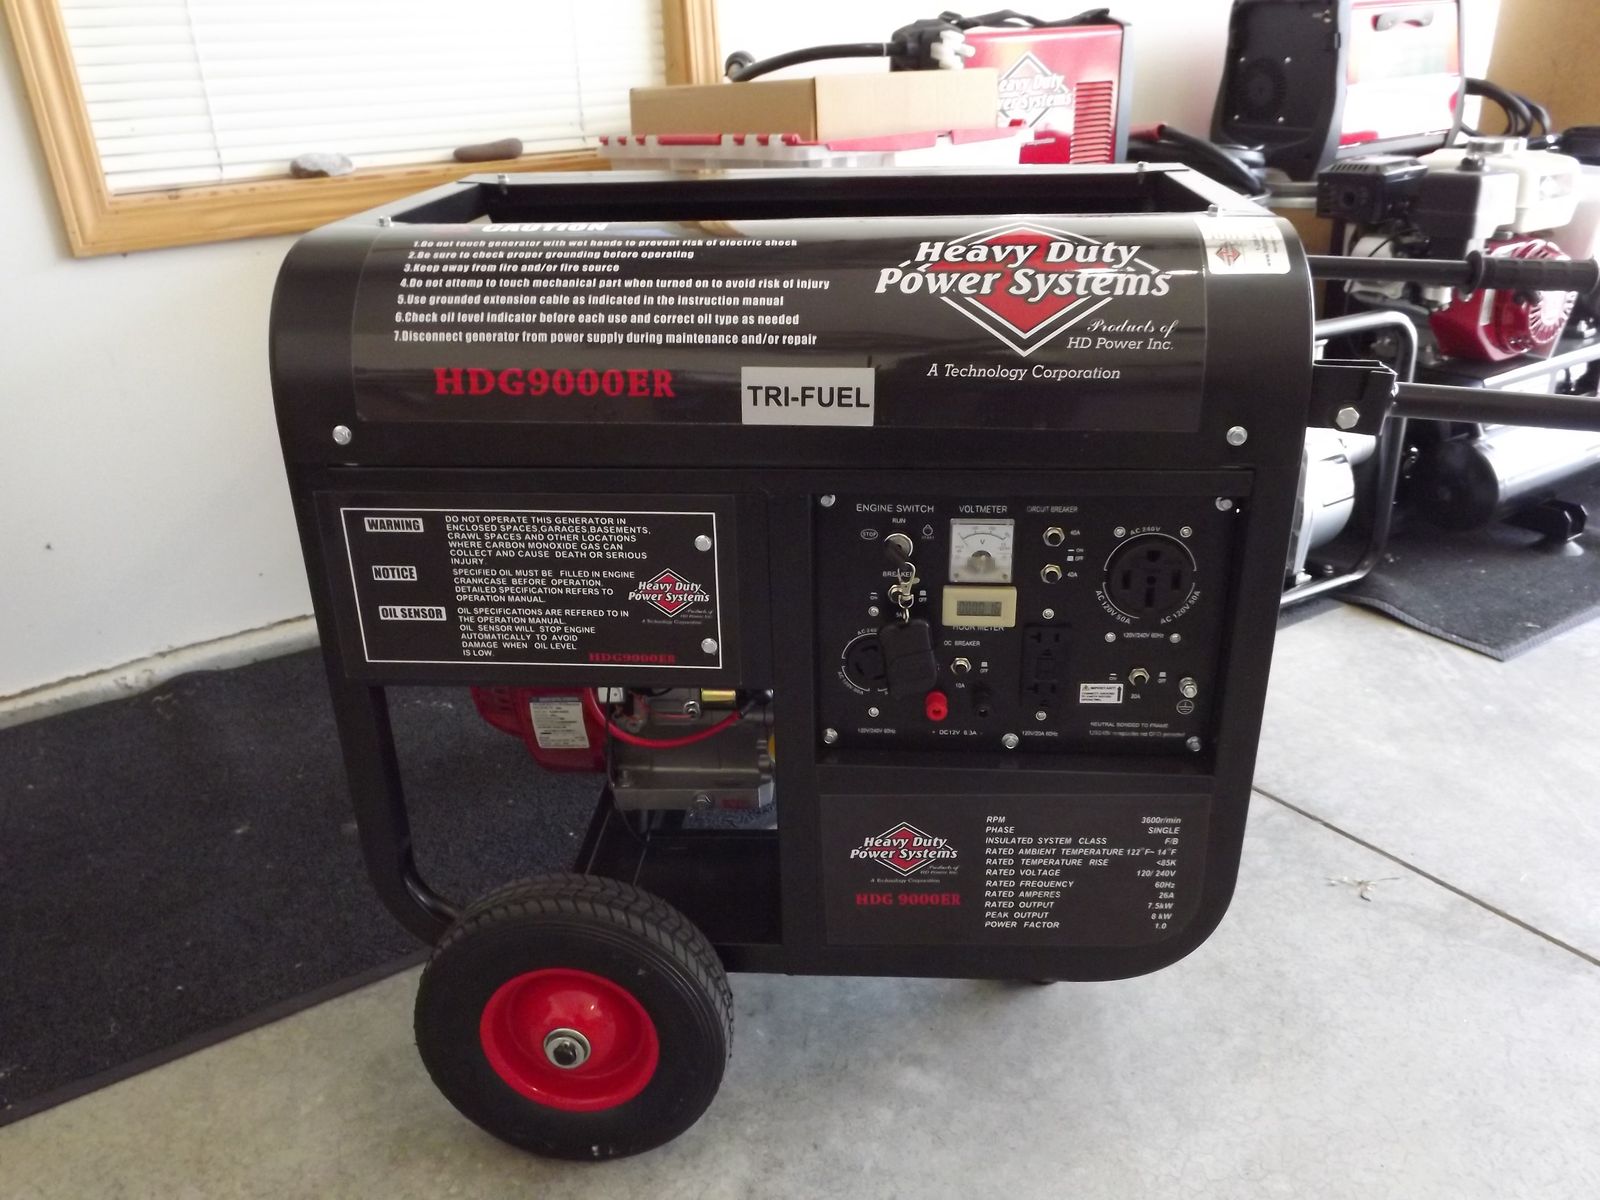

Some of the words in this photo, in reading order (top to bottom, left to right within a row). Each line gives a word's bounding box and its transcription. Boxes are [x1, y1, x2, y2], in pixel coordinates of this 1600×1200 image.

[482, 223, 608, 232] CAUTION
[914, 242, 1037, 268] Heavy
[1046, 242, 1141, 267] Duty
[403, 263, 439, 272] 3.Keep
[471, 263, 496, 271] from
[498, 263, 518, 272] fire
[520, 263, 557, 272] and/or
[560, 263, 579, 272] fire
[400, 278, 422, 287] 4.Do
[425, 278, 443, 287] not
[485, 278, 496, 287] to
[499, 278, 529, 287] touch
[532, 278, 596, 287] mechanical
[598, 278, 621, 288] part
[624, 278, 653, 287] when
[656, 278, 692, 288] turned
[695, 279, 708, 288] on
[711, 279, 722, 288] to
[725, 278, 755, 288] avoid
[758, 278, 779, 288] risk
[782, 278, 794, 288] of
[796, 278, 829, 289] injury
[874, 268, 1002, 294] Power
[1008, 268, 1172, 303] Systems
[1087, 319, 1155, 333] Products
[1159, 320, 1179, 337] of
[393, 330, 462, 341] 7.Disconnect
[465, 332, 519, 342] generator
[522, 331, 547, 342] from
[550, 332, 584, 342] power
[586, 331, 623, 343] supply
[626, 332, 662, 344] during
[666, 332, 738, 343] maintenance
[741, 333, 779, 344] and/or
[782, 333, 816, 345] repair
[1066, 337, 1091, 349] HD
[1095, 337, 1143, 350] Power
[1147, 338, 1174, 350] Inc.
[927, 364, 938, 376] A
[945, 364, 1028, 380] Technology
[1032, 365, 1120, 380] Corporation
[433, 368, 676, 397] HDG9000ER
[747, 386, 870, 408] TRI-FUEL
[856, 504, 893, 512] ENGINE
[896, 504, 934, 512] SWITCH
[959, 505, 1008, 513] VOLTMETER
[367, 519, 420, 530] WARNING
[373, 567, 415, 579] NOTICE
[638, 582, 672, 592] Heavy
[675, 582, 701, 592] Duty
[628, 592, 662, 601] Power
[666, 592, 710, 604] Systems
[1096, 590, 1104, 601] AC
[1102, 601, 1117, 616] 120V
[381, 608, 398, 618] OIL
[400, 608, 443, 619] SENSOR
[1161, 616, 1172, 624] AC
[1173, 604, 1190, 618] 120V
[864, 837, 908, 849] Heavy
[912, 837, 947, 849] Duty
[850, 849, 895, 859] Power
[899, 849, 958, 861] Systems
